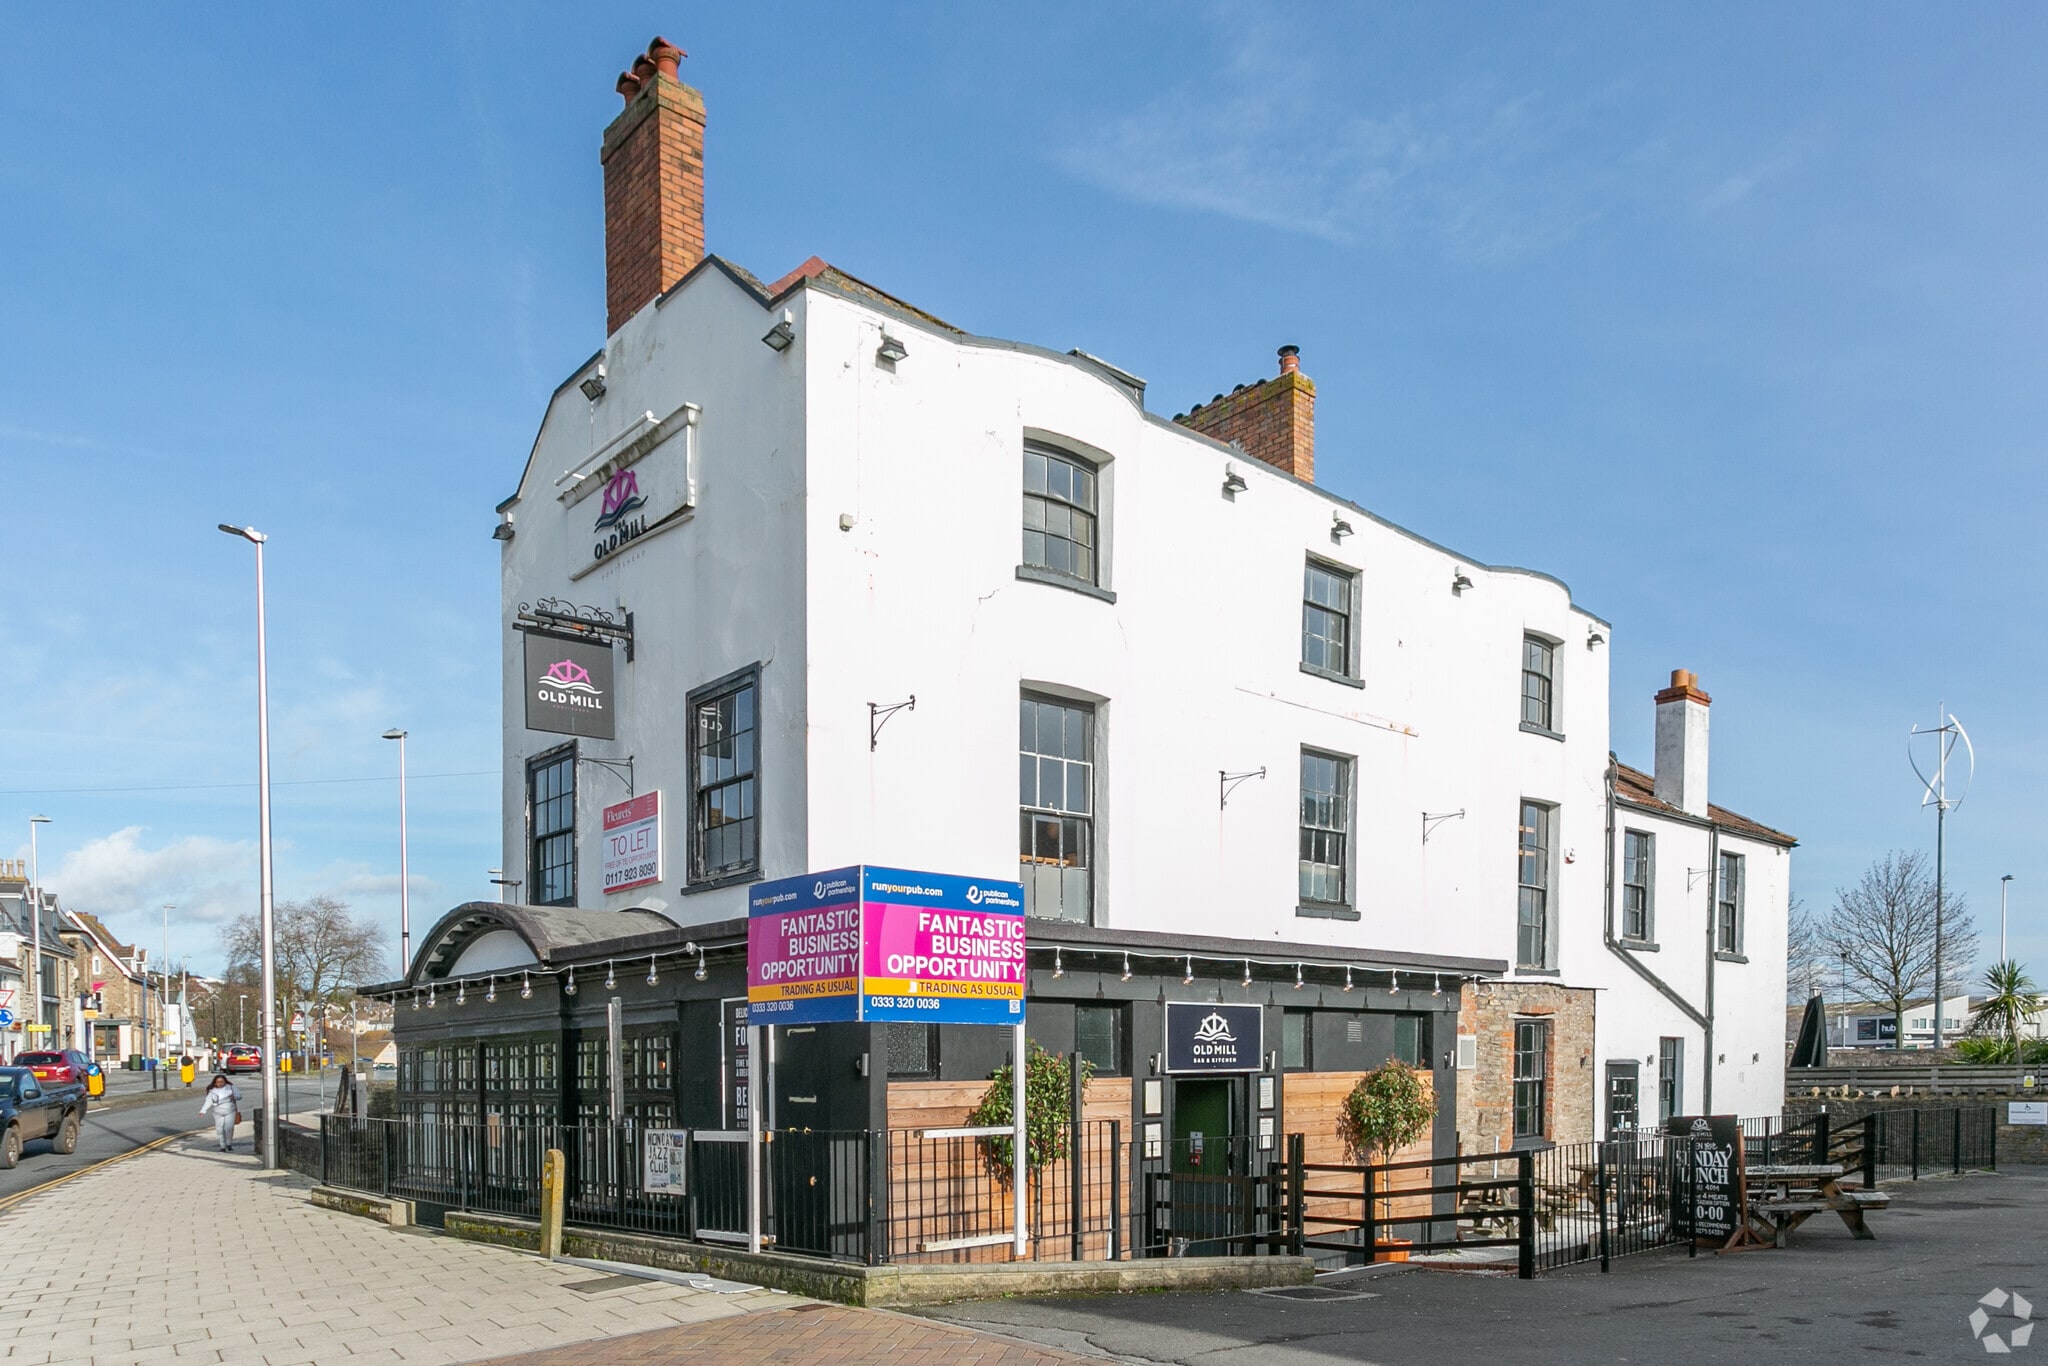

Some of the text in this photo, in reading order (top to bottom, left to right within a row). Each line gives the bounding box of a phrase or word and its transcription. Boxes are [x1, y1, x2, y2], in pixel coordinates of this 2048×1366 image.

[594, 514, 647, 560] OLD MILL
[538, 689, 567, 704] OLD
[570, 694, 603, 710] MILL
[611, 827, 651, 857] TO LET
[605, 861, 656, 885] 0117 923 8090
[826, 880, 847, 890] publican
[827, 886, 856, 897] partnerships
[872, 882, 943, 897] runyourpub.com
[753, 892, 797, 906] runyourpub.com
[983, 890, 1009, 899] publican
[985, 896, 1020, 907] partnerships
[781, 908, 858, 937] FANTASTIC
[919, 912, 1024, 940] FANTASTIC
[789, 930, 859, 957] BUSINESS
[932, 935, 1024, 960] BUSINESS
[761, 952, 858, 980] OPPORTUNITY
[887, 954, 1024, 981] OPPORTUNITY
[781, 979, 855, 997] TRADING AS USUAL
[919, 981, 1019, 997] TRADING AS USUAL
[752, 1000, 794, 1013] 0333 320 0036
[871, 996, 940, 1010] 0333 320 0036
[1881, 1024, 1896, 1032] hub
[1193, 1045, 1237, 1055] OLD MILL
[647, 1132, 674, 1147] MONDAY
[648, 1146, 668, 1160] JAZZ
[649, 1159, 669, 1174] CLUB
[1708, 1193, 1729, 1201] MEATS
